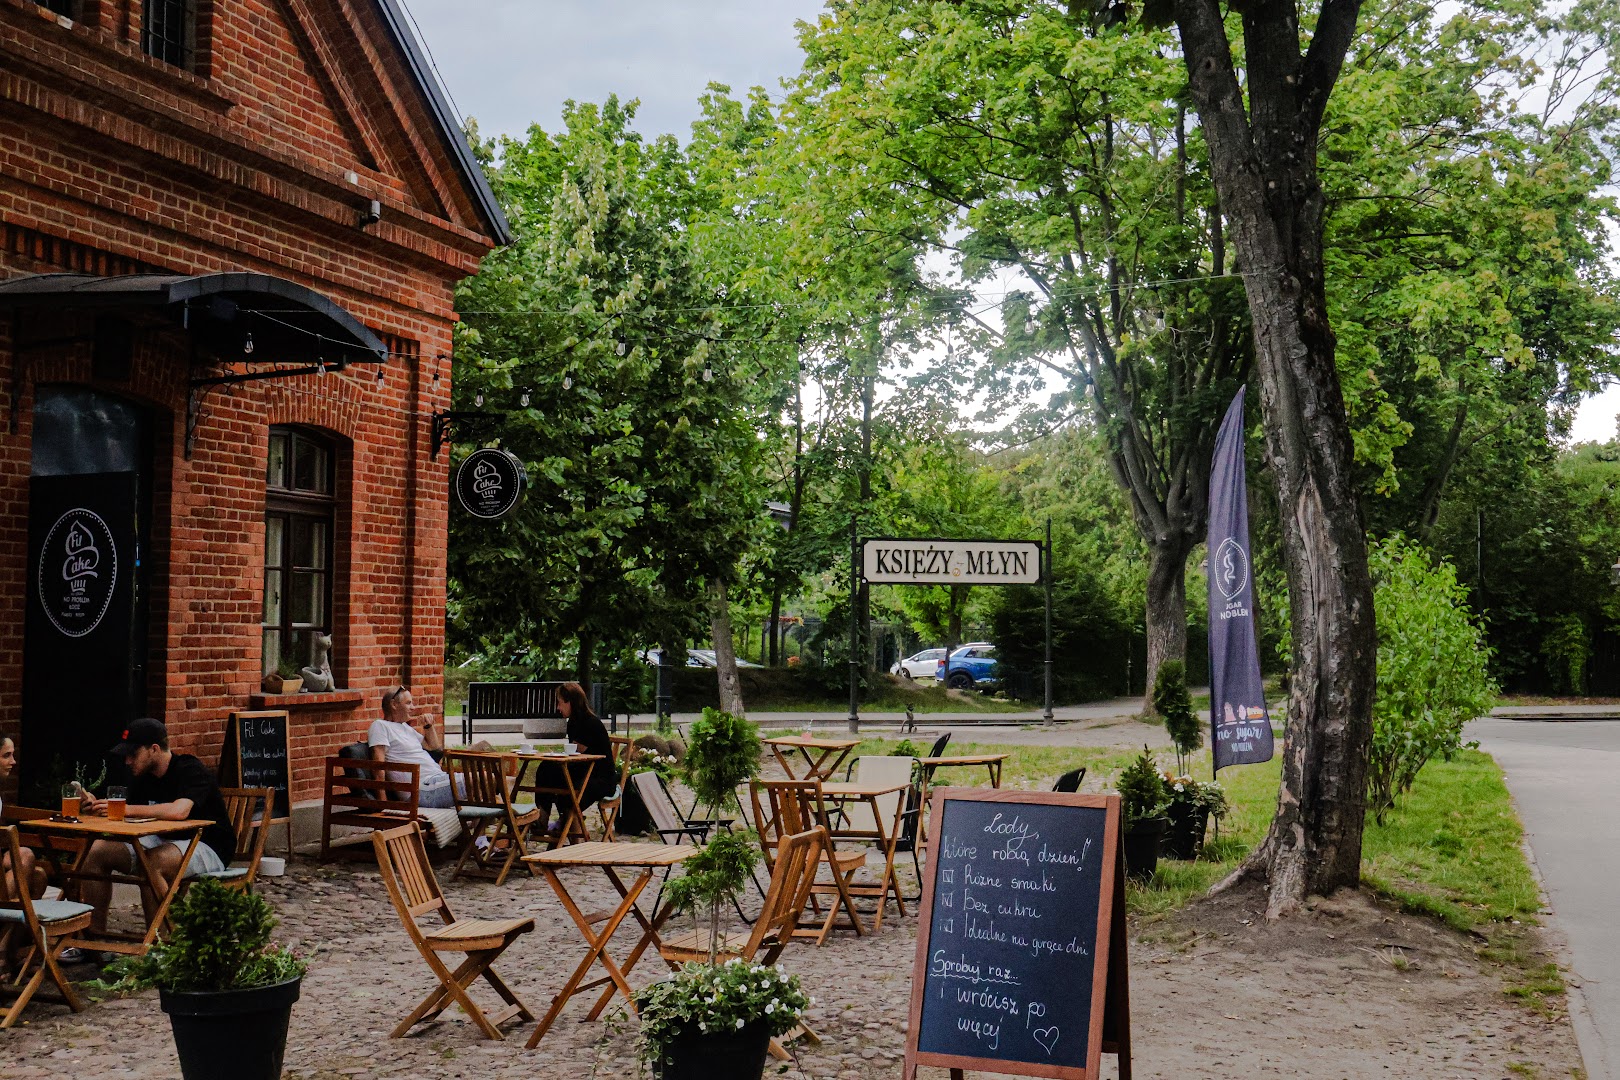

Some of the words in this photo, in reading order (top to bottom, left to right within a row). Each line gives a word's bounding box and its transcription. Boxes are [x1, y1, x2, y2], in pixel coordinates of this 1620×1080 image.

[63, 556, 92, 580] Cake
[875, 545, 954, 578] KSIĘŻY
[966, 550, 1028, 575] MŁYN
[244, 720, 254, 738] Fit
[1217, 729, 1232, 740] no
[1236, 727, 1262, 741] sugar
[984, 813, 1040, 850] Lody,
[943, 836, 977, 859] które
[993, 841, 1029, 866] robią
[1011, 869, 1056, 892] smaki
[963, 888, 989, 914] Bez
[998, 899, 1041, 918] cukru
[964, 912, 1007, 942] Idealne
[1012, 935, 1028, 946] na
[1066, 937, 1088, 955] dni
[957, 982, 1018, 1015] wrócisz
[1026, 1001, 1046, 1029] po
